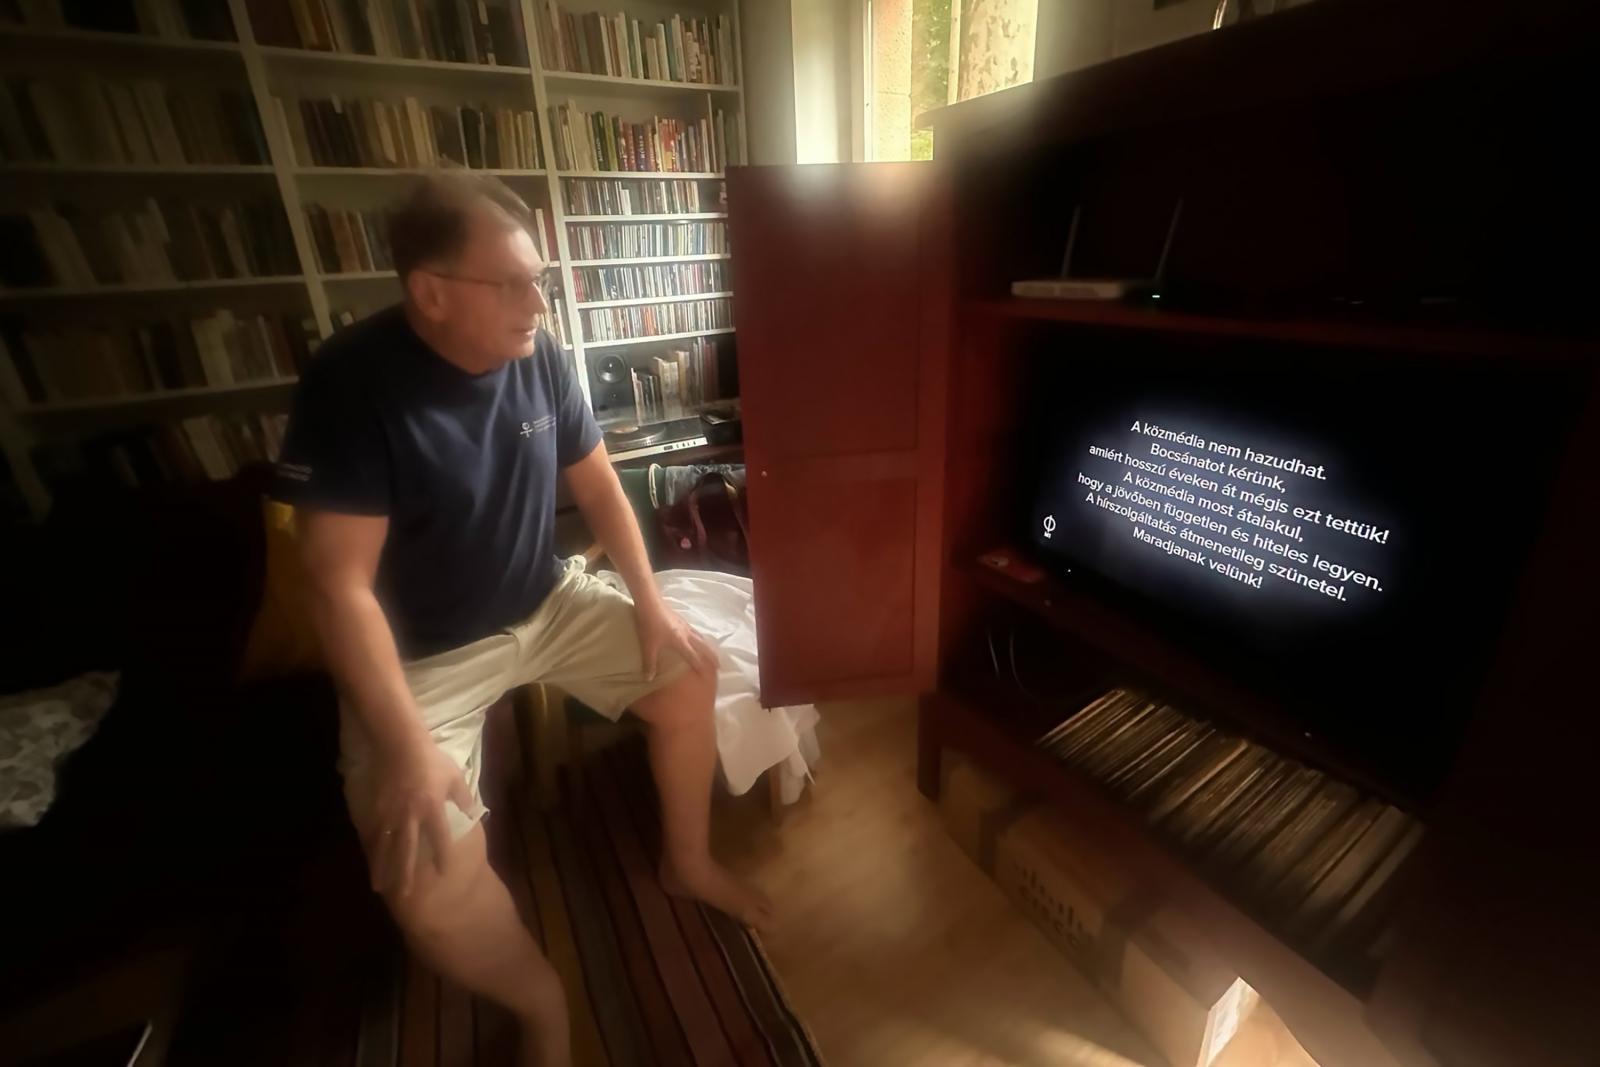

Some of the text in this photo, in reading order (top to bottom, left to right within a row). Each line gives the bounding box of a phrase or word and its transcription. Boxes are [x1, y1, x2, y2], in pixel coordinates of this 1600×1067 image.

[1130, 420, 1327, 480] A közmédia nem hazudhat.
[1150, 442, 1287, 494] Bocsánatot kérünk,
[1089, 445, 1390, 544] amiért hosszú éveken át mégis ezt tettük!
[1123, 471, 1304, 543] A közmédia most átalakul,
[1078, 472, 1383, 592] hogy a jövőben független és hiteles legyen.
[1085, 492, 1346, 602] A hírszolgáltatás átmenetileg szünetel.
[1132, 526, 1263, 589] Maradjanak velünk!
